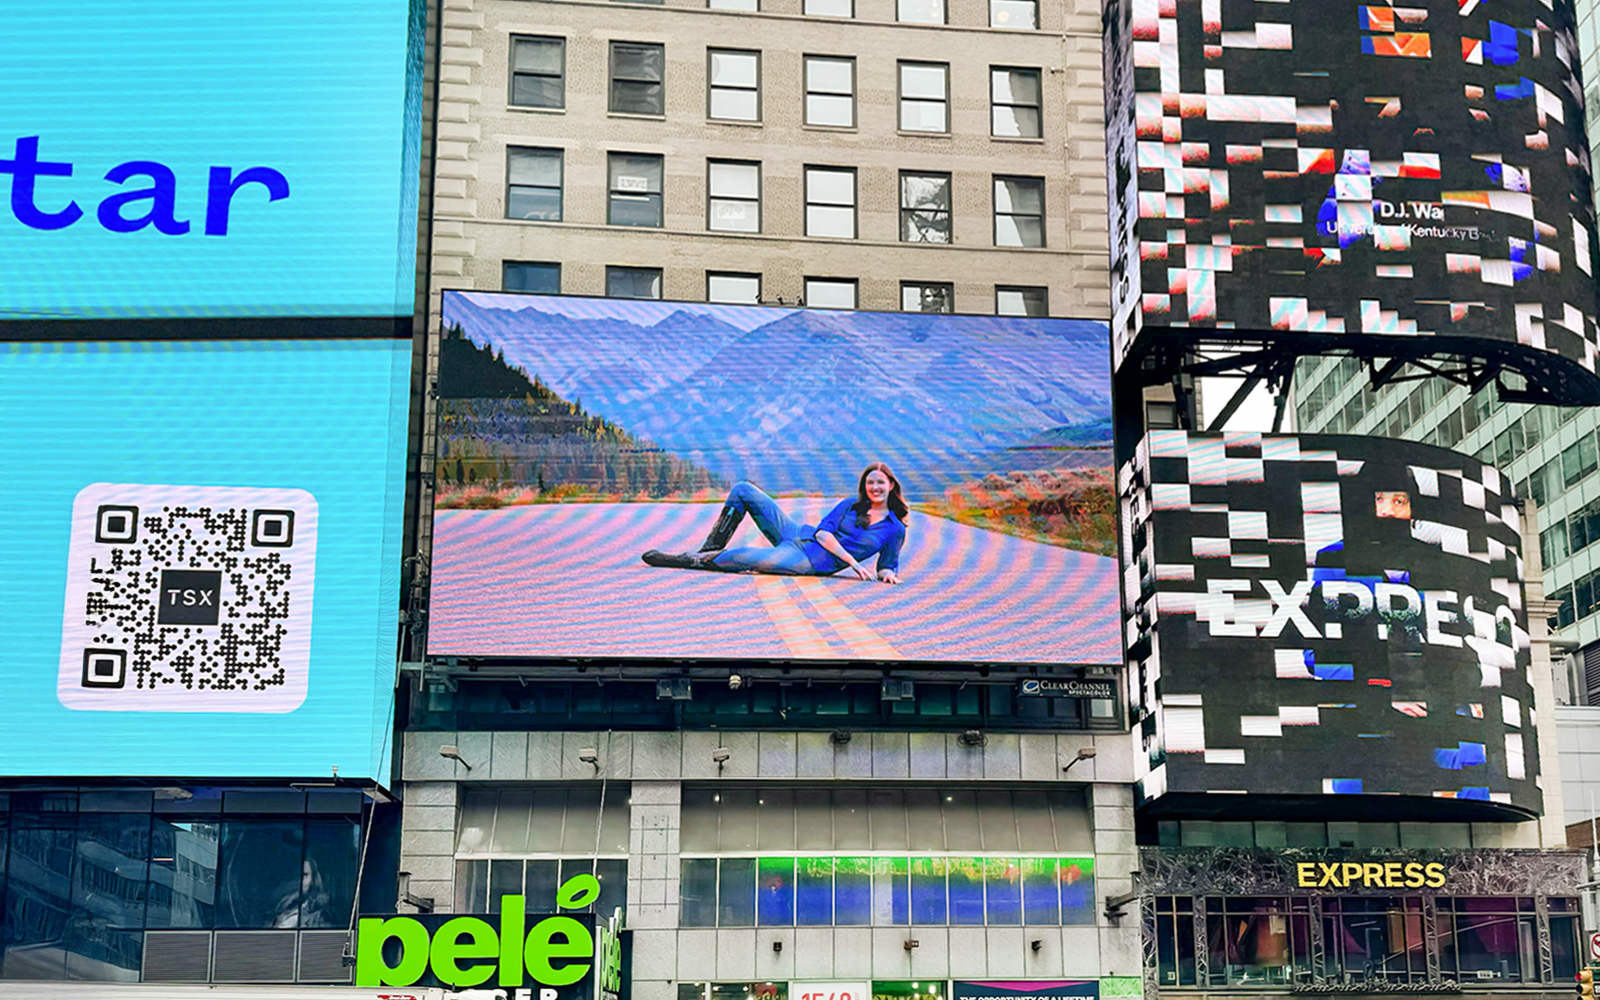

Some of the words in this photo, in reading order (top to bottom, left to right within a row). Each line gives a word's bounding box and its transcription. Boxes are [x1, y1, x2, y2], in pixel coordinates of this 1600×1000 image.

[0, 135, 290, 236] tar
[1381, 202, 1410, 219] D.J.
[167, 589, 213, 606] TSX
[1297, 862, 1446, 888] EXPRESS
[356, 873, 600, 987] pelé
